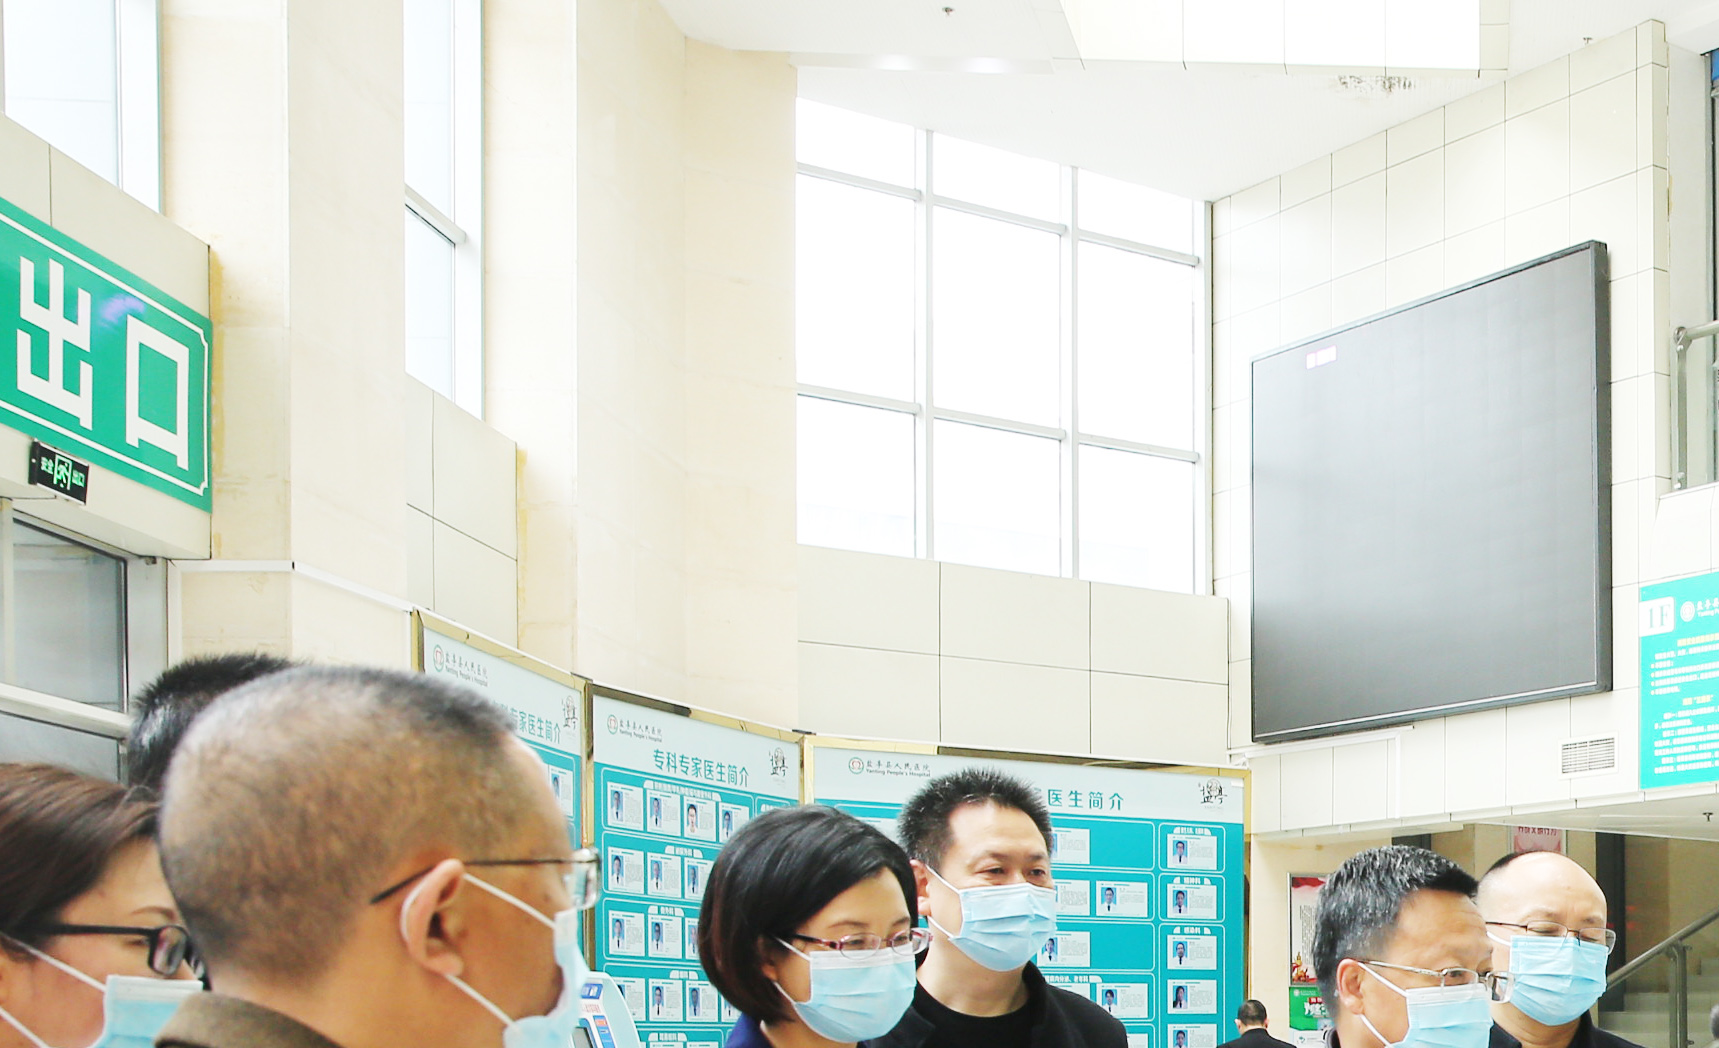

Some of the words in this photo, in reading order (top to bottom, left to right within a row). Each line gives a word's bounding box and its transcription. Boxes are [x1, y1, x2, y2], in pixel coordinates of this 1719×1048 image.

[16, 255, 190, 472] 出口
[1649, 603, 1671, 629] 1F
[653, 748, 749, 787] 专科专家医生简介
[1036, 788, 1124, 811] 医生简介
